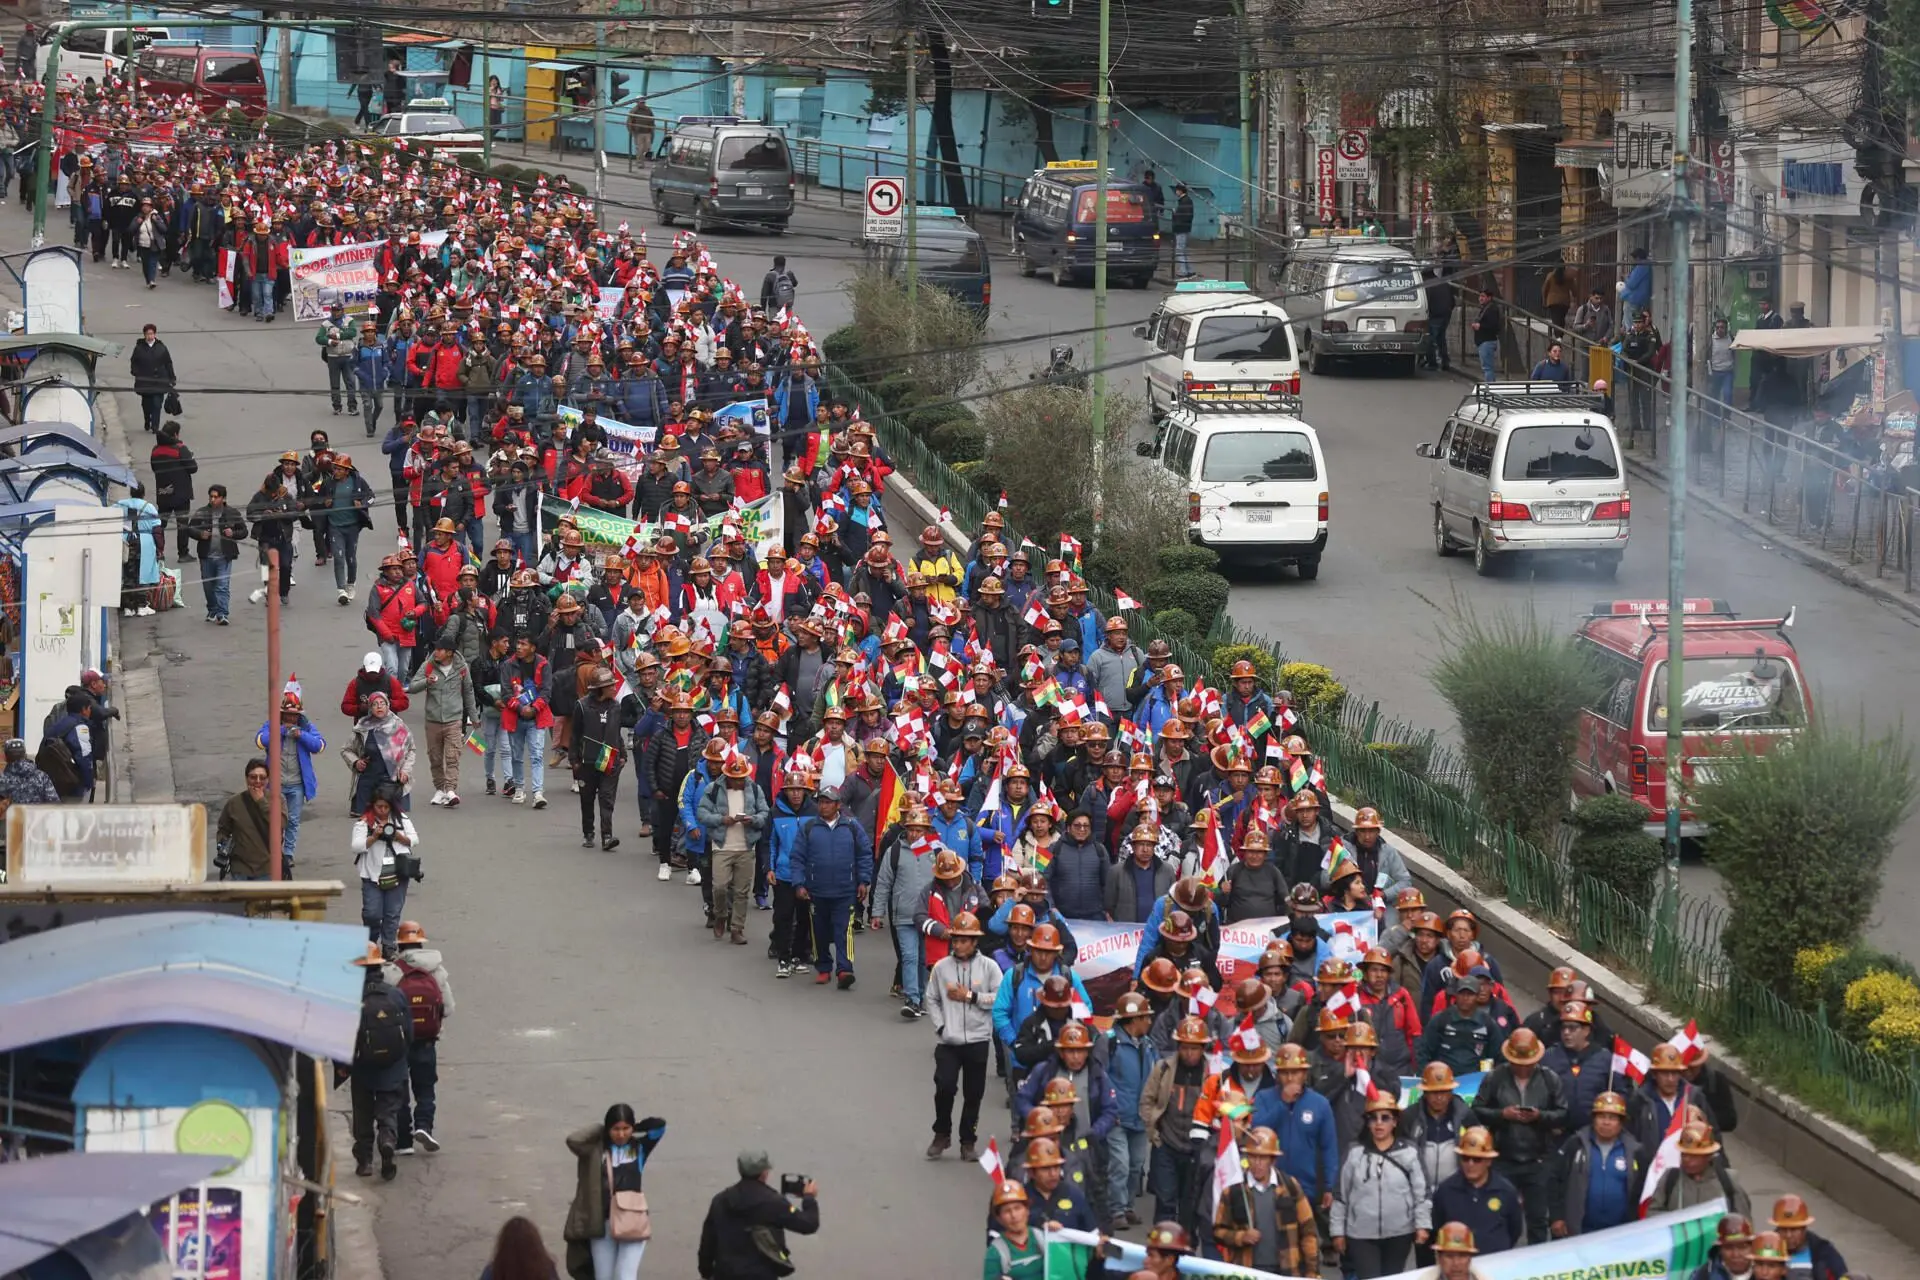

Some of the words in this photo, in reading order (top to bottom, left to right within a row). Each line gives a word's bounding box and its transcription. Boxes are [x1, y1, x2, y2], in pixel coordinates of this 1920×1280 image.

[1321, 150, 1334, 222] OPTICA
[1697, 684, 1760, 698] FIGHTERS
[1079, 932, 1131, 963] ERATIVA
[1222, 928, 1257, 948] CADA
[1518, 1258, 1666, 1280] OPERATIVAS
